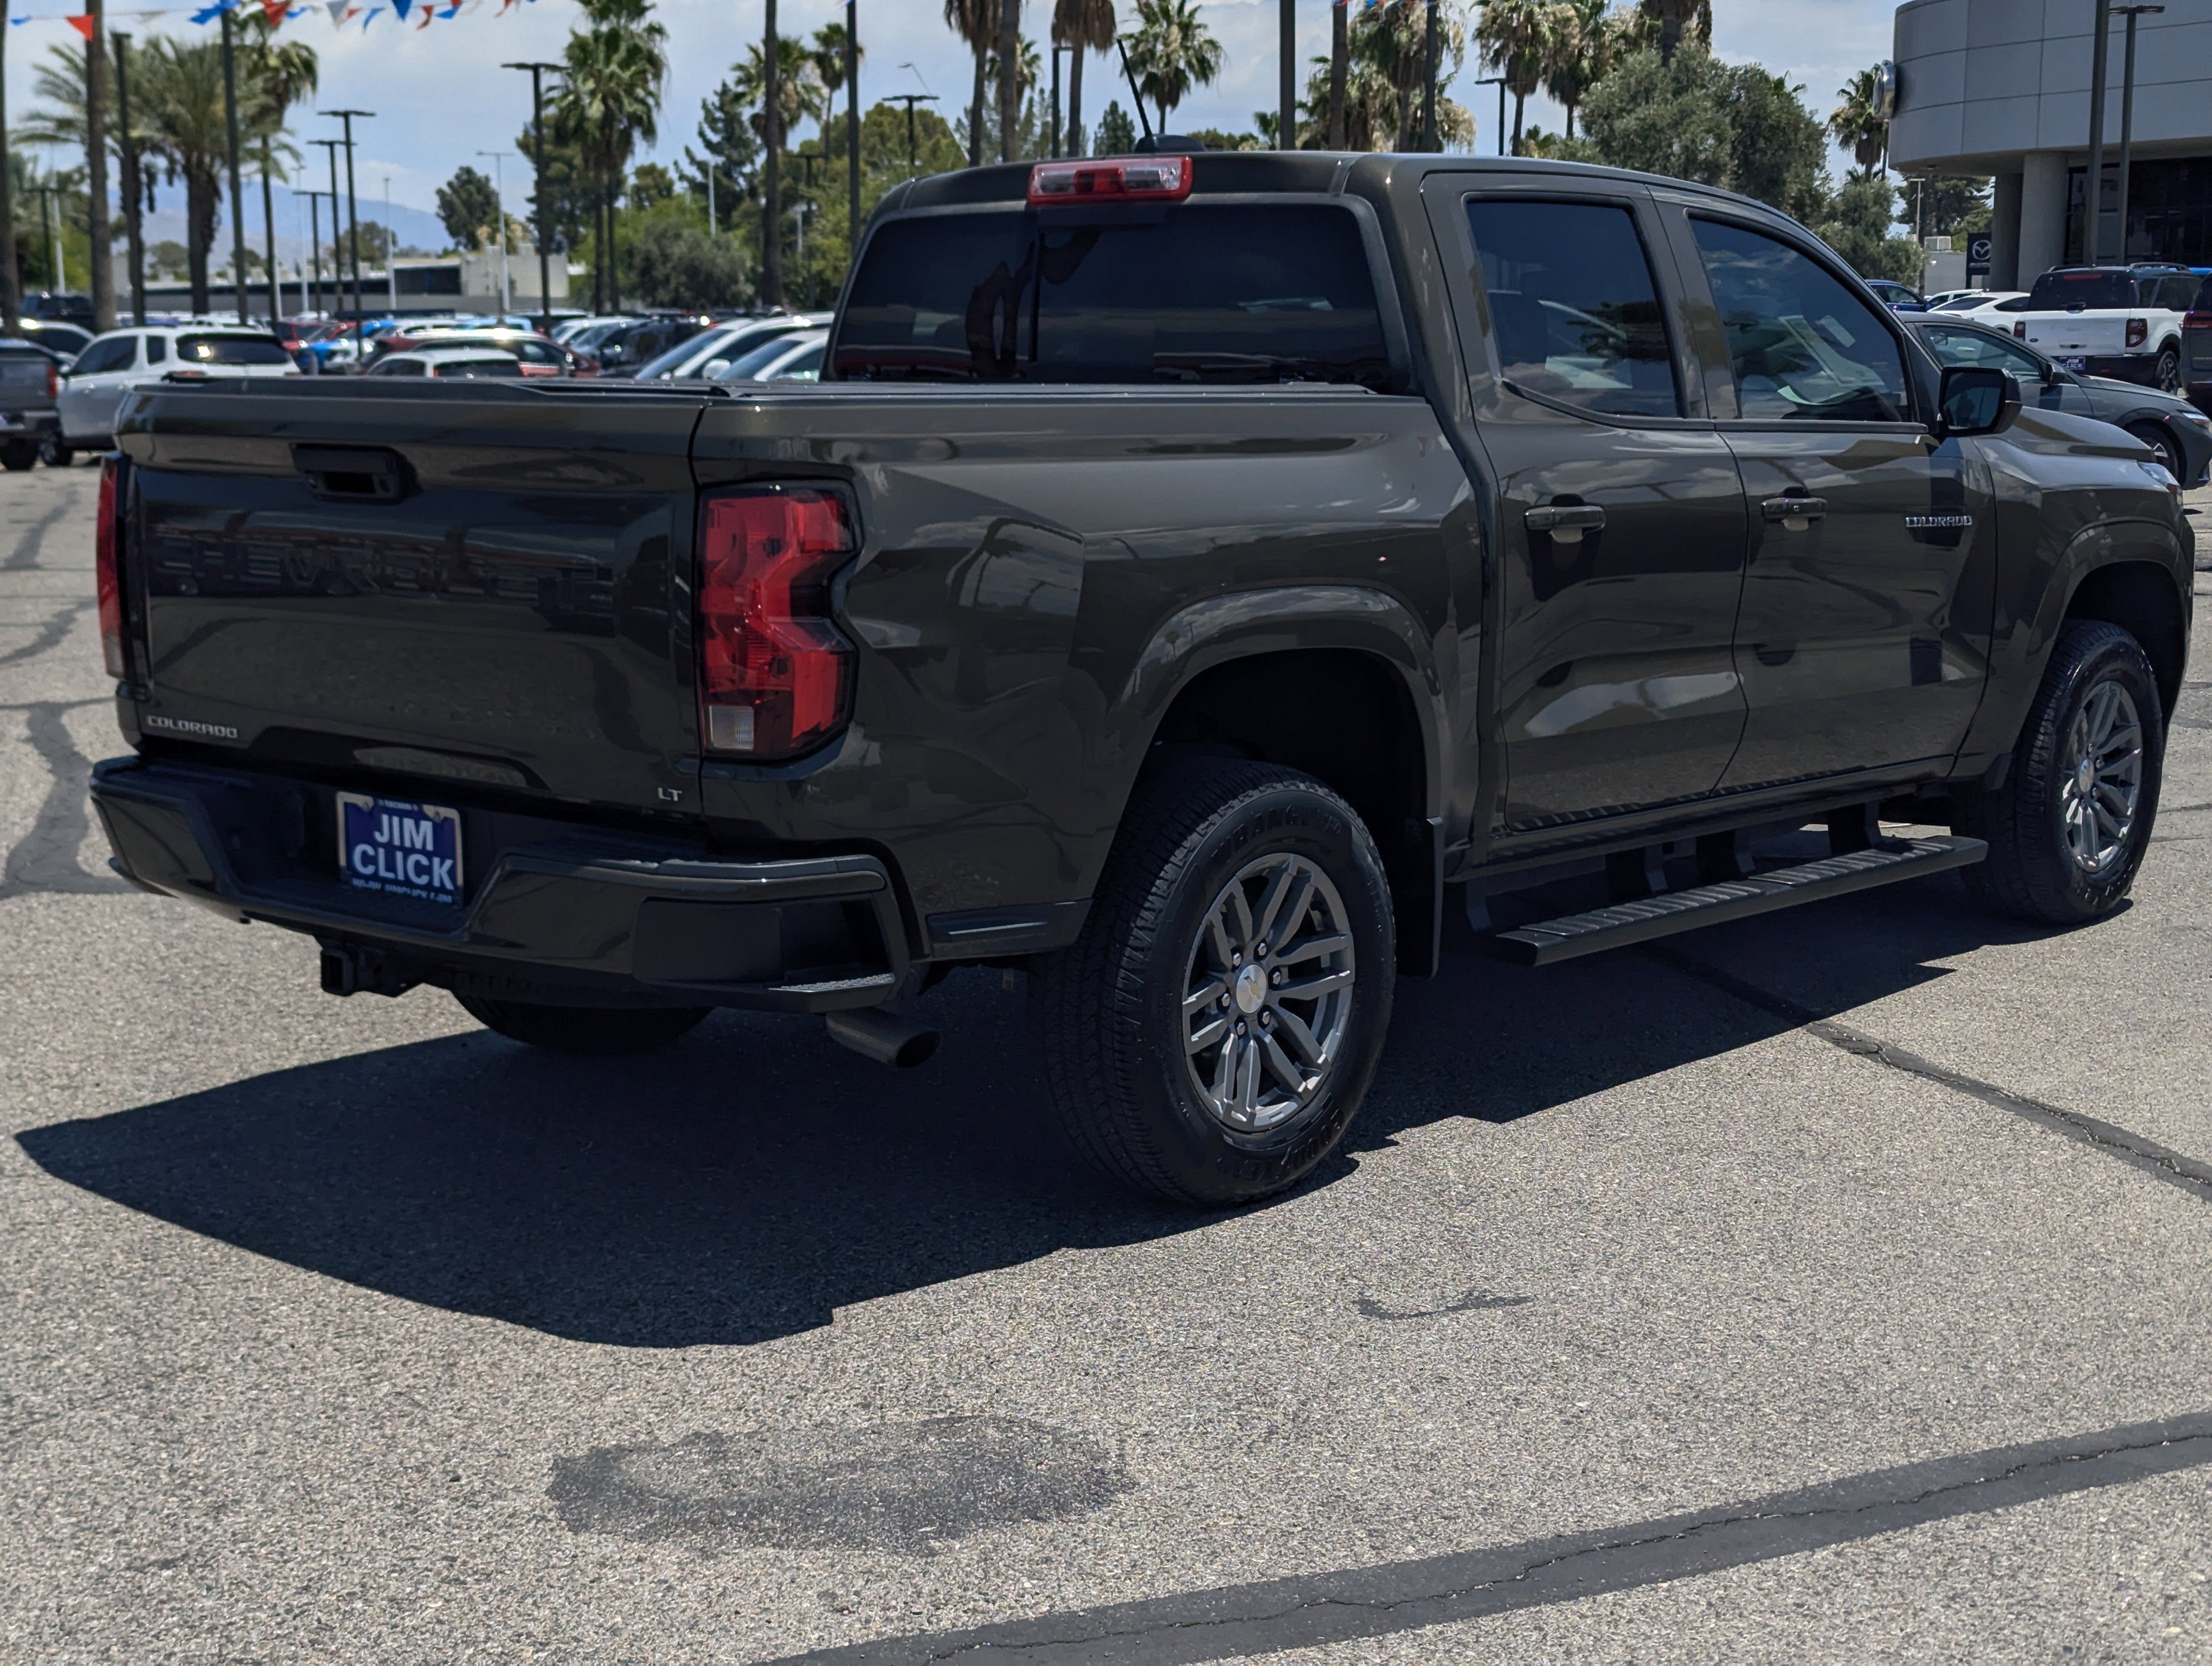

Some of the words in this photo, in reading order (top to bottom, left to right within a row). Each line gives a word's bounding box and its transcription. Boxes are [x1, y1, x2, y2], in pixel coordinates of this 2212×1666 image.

[1906, 516, 1972, 527] COLORADO
[147, 715, 237, 739] COLORADO
[658, 787, 683, 801] LT
[374, 813, 434, 851] JIM
[353, 843, 454, 890] CLICK
